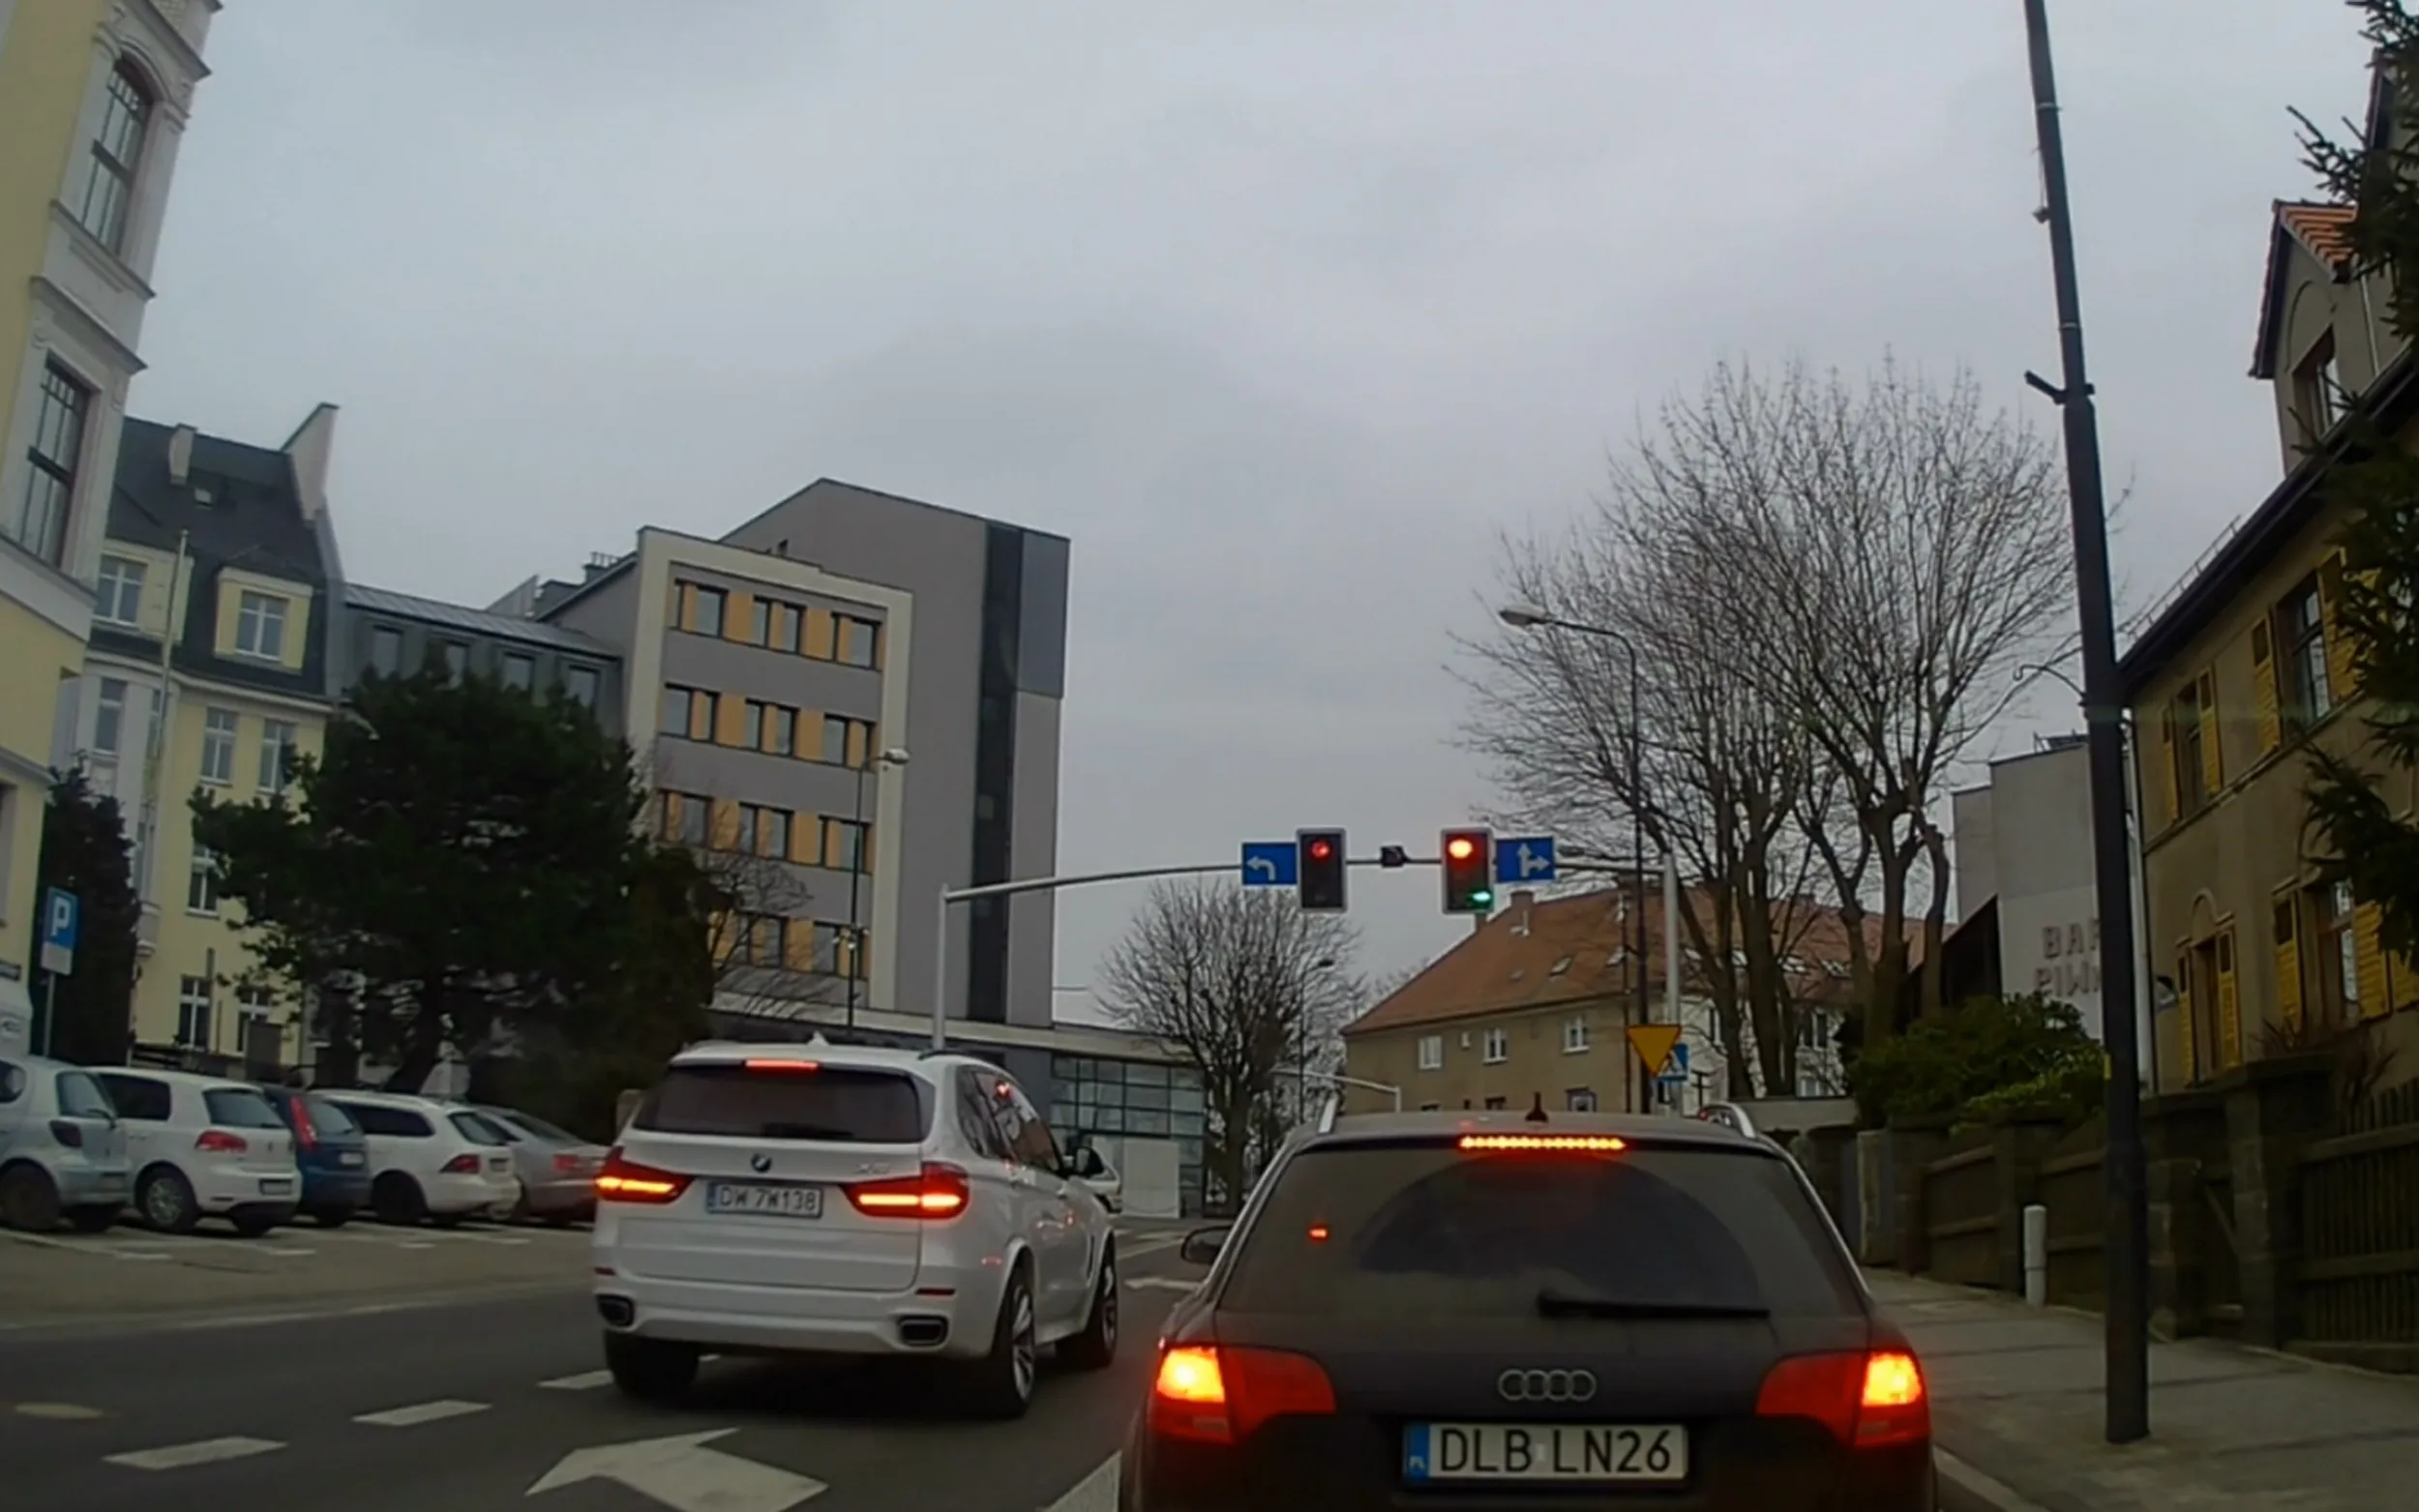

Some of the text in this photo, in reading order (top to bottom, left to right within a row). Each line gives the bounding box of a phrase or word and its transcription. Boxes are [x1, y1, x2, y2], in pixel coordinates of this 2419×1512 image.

[50, 896, 72, 936] P
[721, 1185, 748, 1206] DW
[1440, 1428, 1671, 1473] DLB LN26
